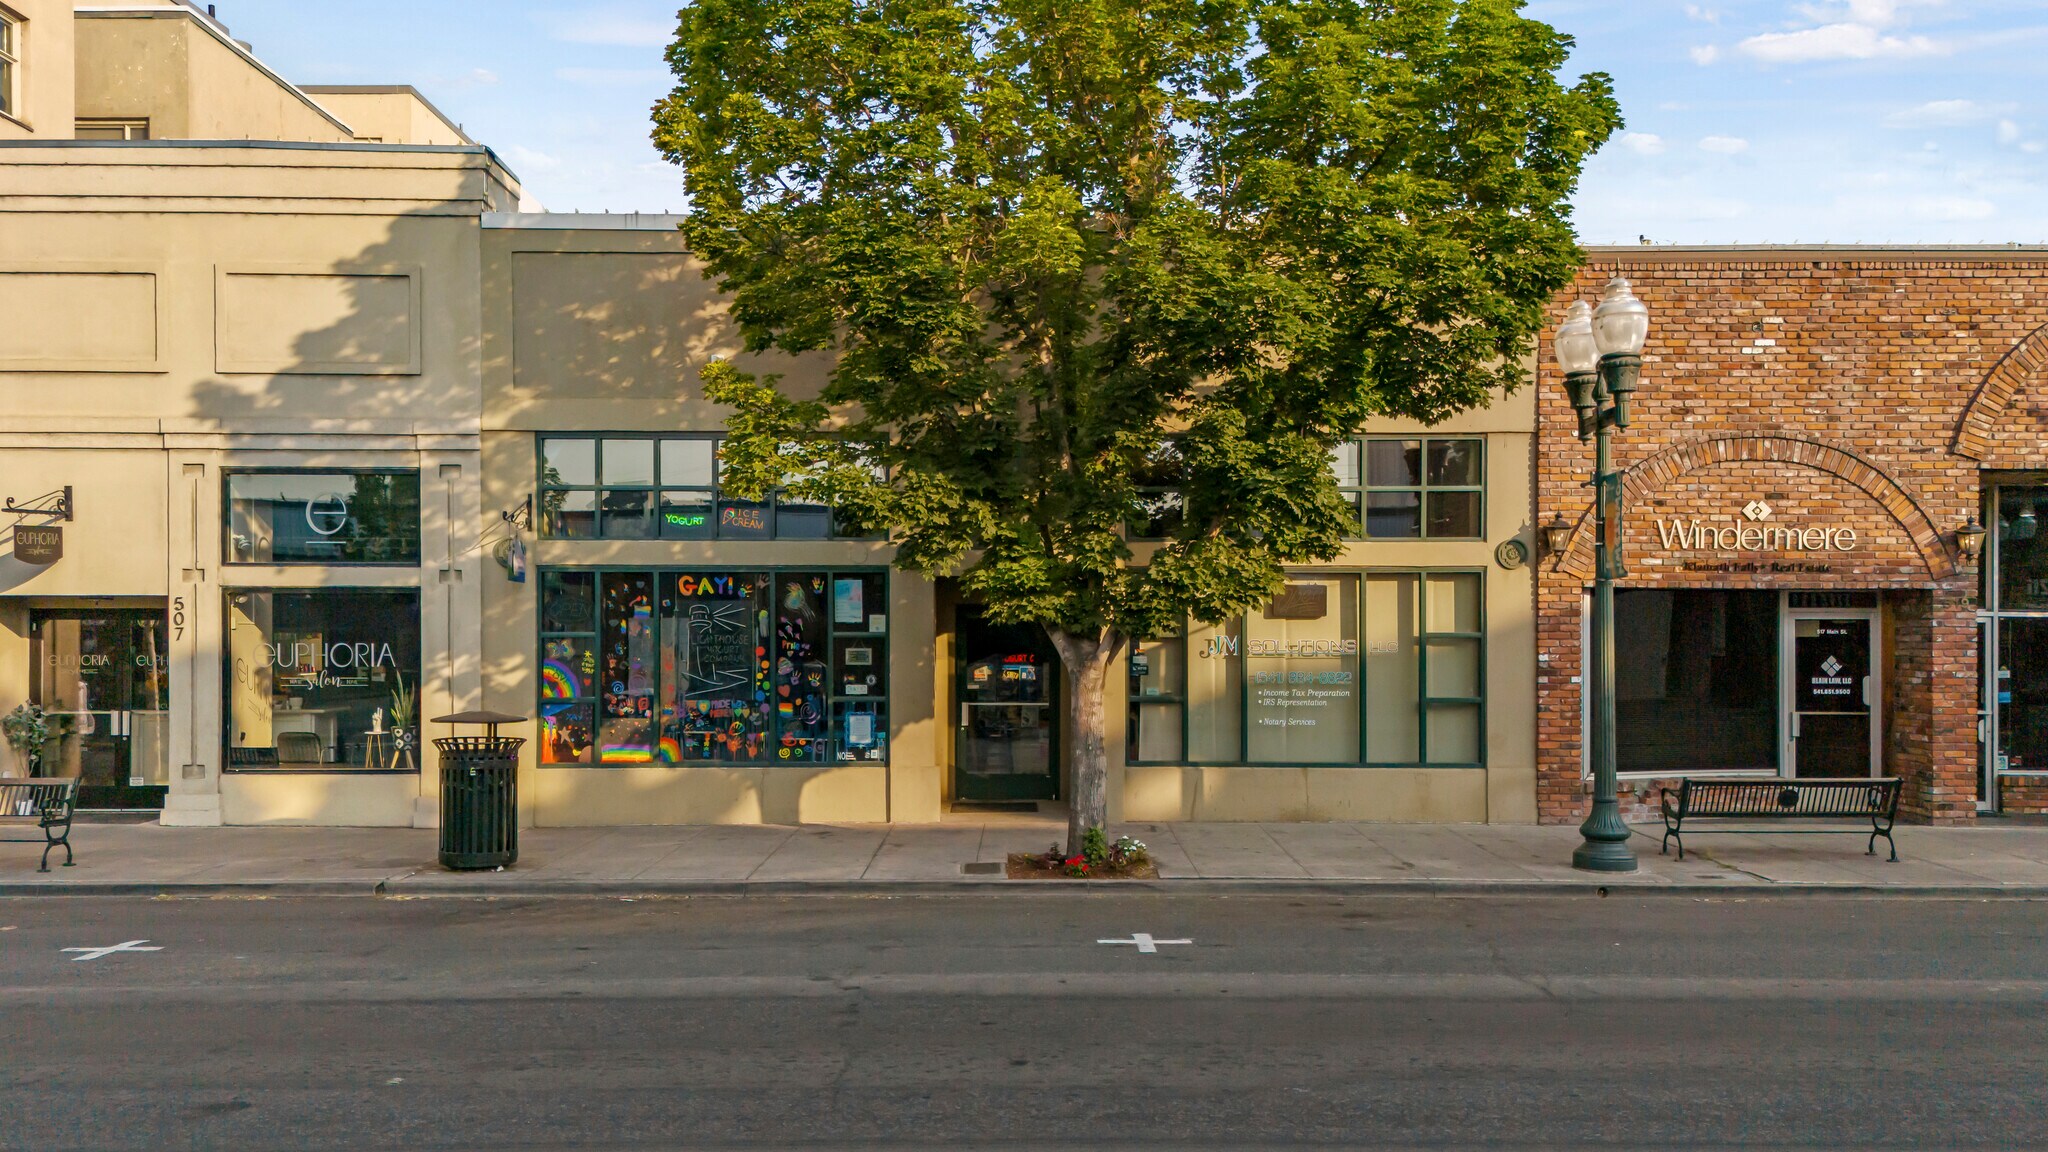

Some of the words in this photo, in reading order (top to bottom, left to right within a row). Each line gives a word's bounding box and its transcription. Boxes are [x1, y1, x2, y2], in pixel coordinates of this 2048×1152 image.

[665, 513, 705, 527] YOGURT
[738, 509, 759, 519] ICE
[732, 517, 764, 530] CREAM
[1656, 518, 1857, 551] Windermere
[678, 575, 734, 597] GAY!
[173, 597, 185, 641] 507
[1248, 639, 1358, 656] SOLUTIONS
[1369, 640, 1399, 653] LLC
[307, 669, 342, 691] salon
[1263, 689, 1290, 697] Income
[1292, 689, 1306, 697] Tax
[1307, 689, 1351, 698] Preparation
[1263, 698, 1276, 706] IRS
[1277, 698, 1328, 708] Representation
[1263, 717, 1286, 727] Notary
[1287, 717, 1316, 726] Services
